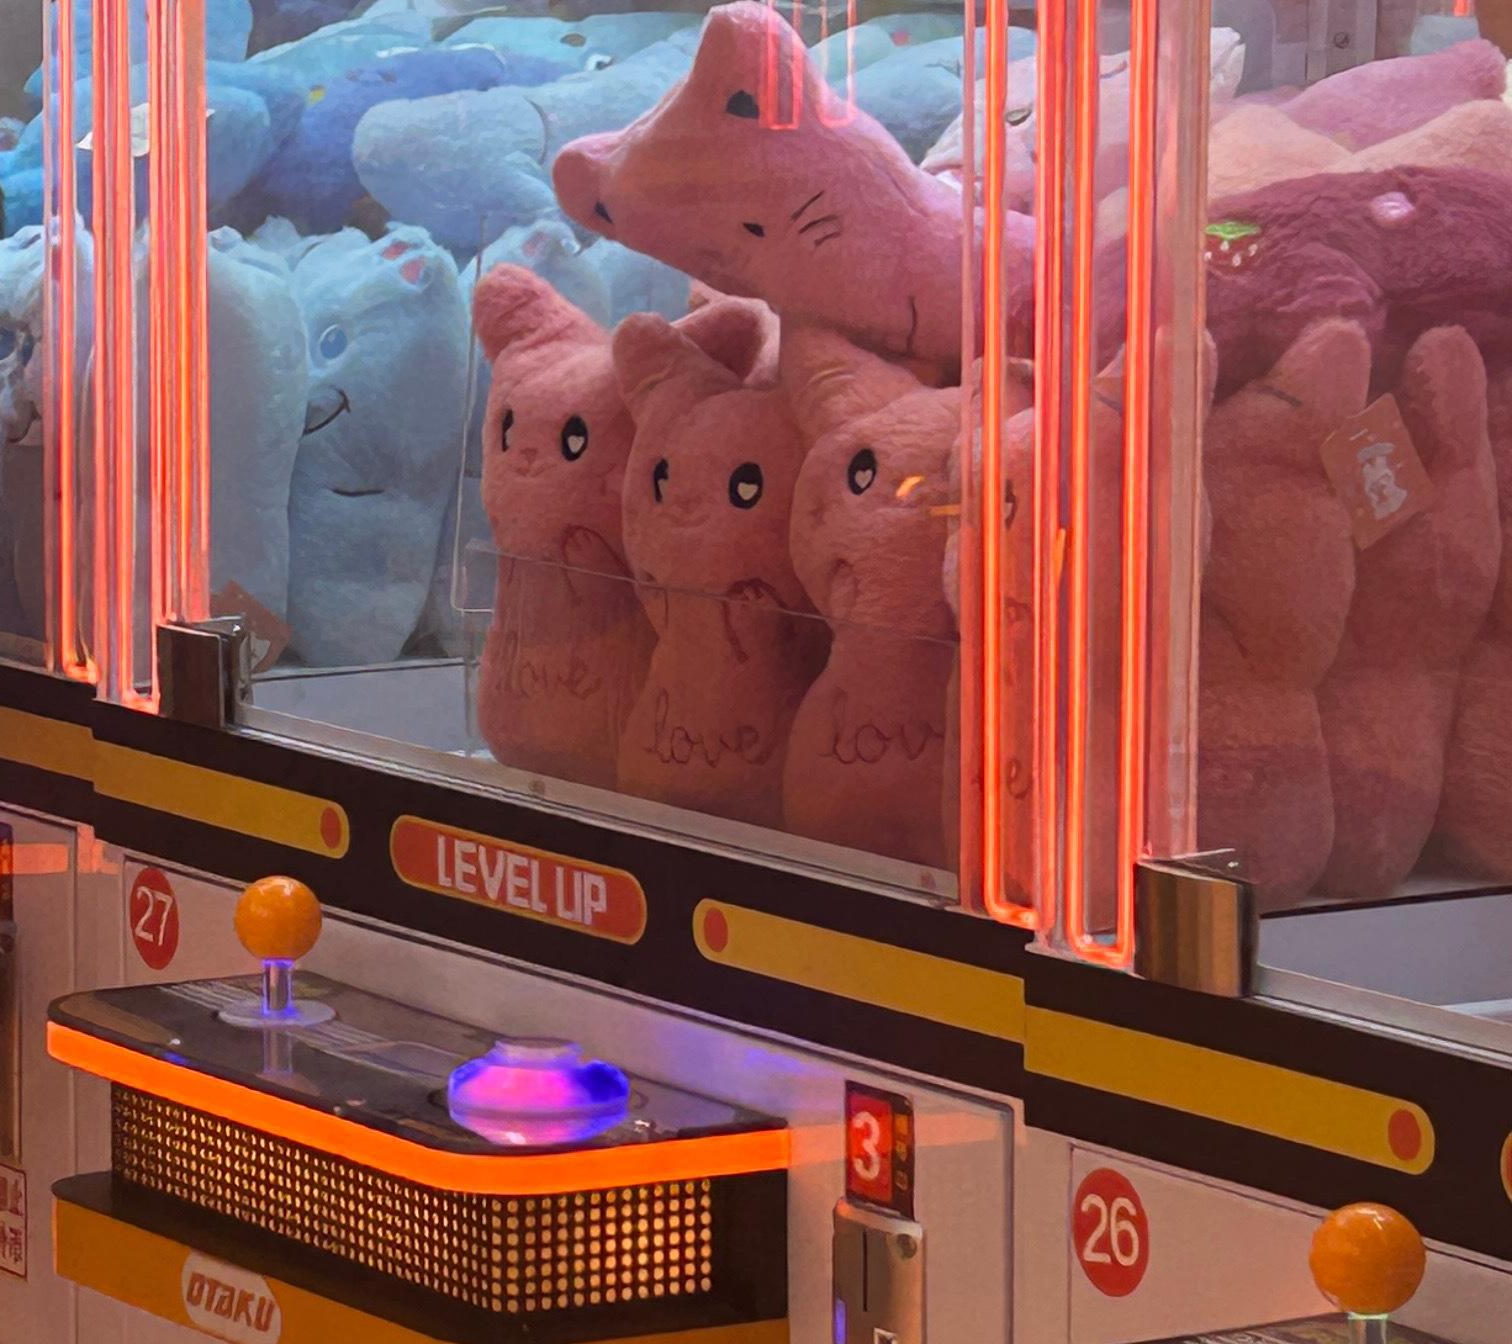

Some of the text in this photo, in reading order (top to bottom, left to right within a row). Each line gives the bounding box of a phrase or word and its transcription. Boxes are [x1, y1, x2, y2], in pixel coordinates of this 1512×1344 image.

[643, 688, 776, 769] love
[817, 685, 946, 766] lov
[133, 889, 175, 948] 27
[437, 833, 608, 927] LEVEL UP
[851, 1110, 881, 1182] 3
[1081, 1192, 1142, 1269] 26
